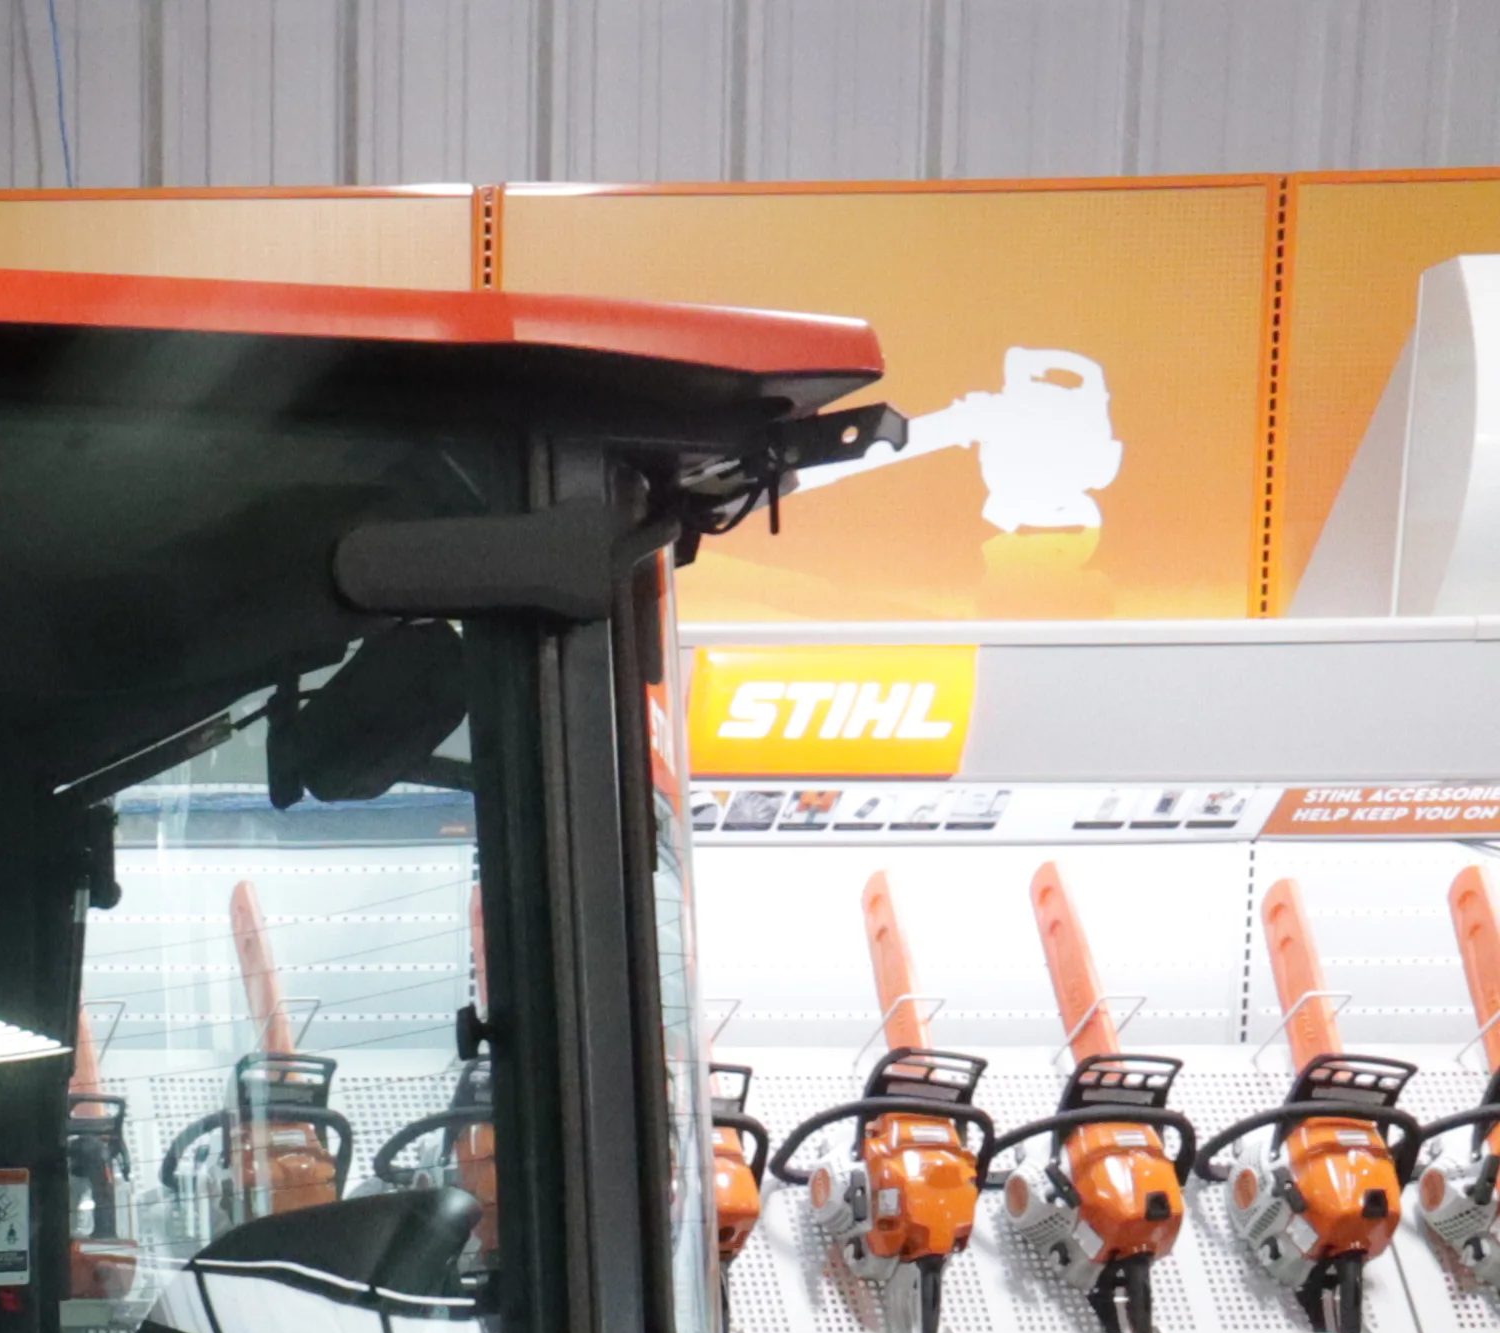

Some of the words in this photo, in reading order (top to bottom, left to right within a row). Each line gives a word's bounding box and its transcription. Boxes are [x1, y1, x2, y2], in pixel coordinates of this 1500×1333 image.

[718, 681, 953, 739] STIHL
[1303, 788, 1364, 803] STIHL
[1292, 807, 1348, 821] HELP
[1351, 807, 1411, 821] KEEP
[1414, 806, 1461, 821] YOU
[1463, 806, 1499, 819] ON
